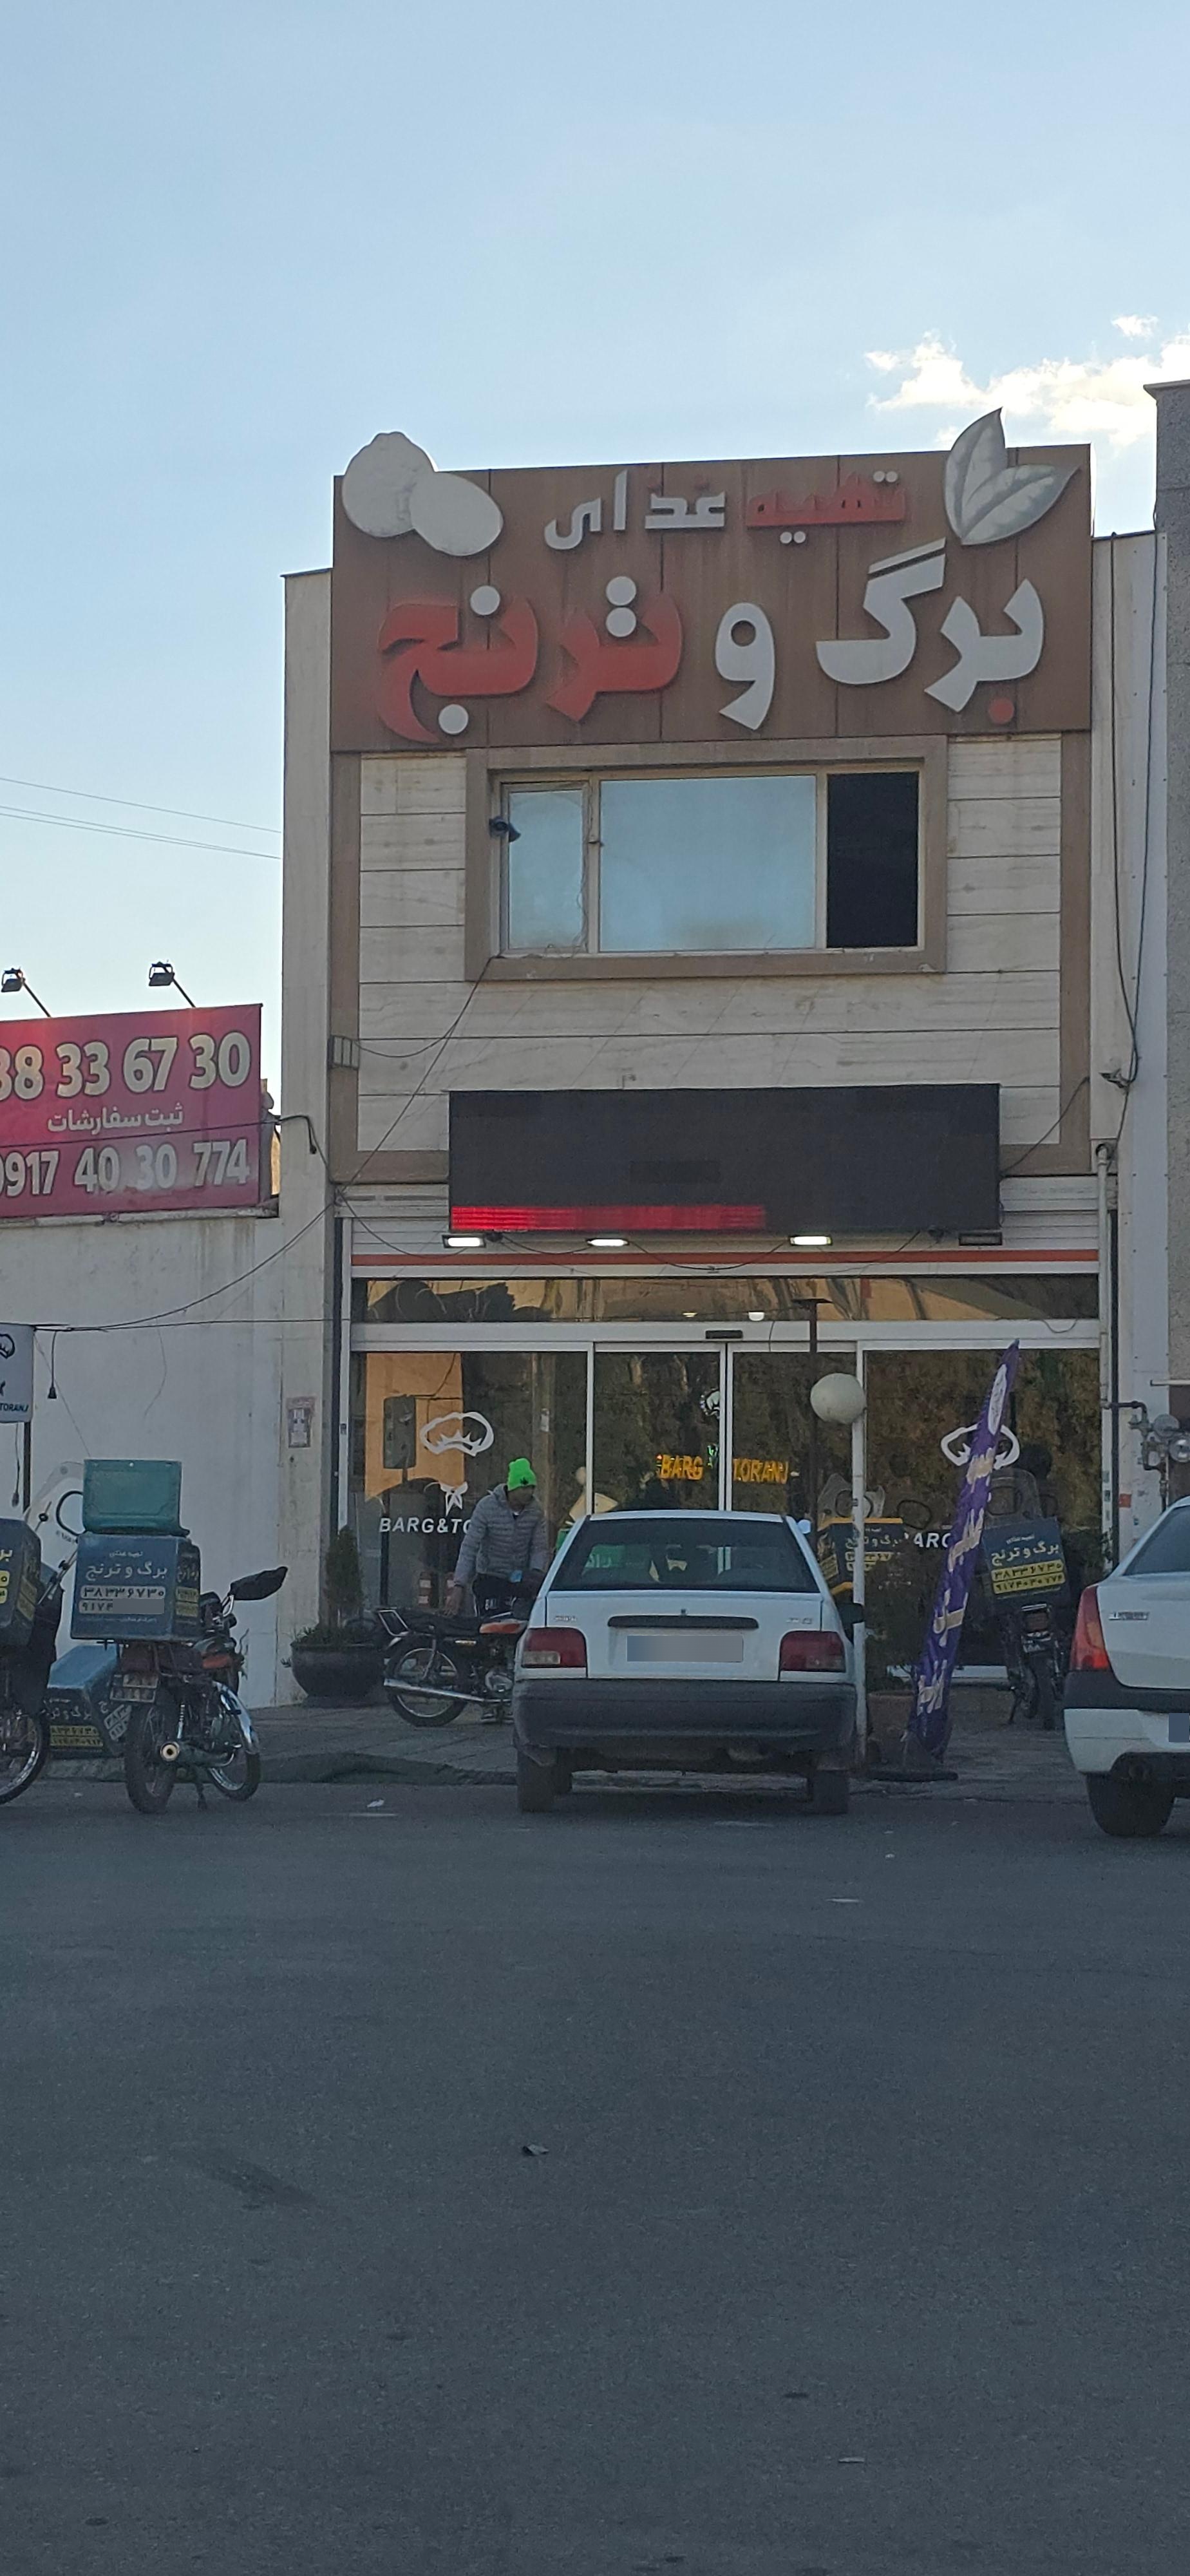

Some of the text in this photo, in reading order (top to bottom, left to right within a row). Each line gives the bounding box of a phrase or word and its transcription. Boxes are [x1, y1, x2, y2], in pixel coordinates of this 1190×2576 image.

[746, 471, 905, 544] تهیه
[378, 538, 1044, 743] برگ و ترنج
[56, 1041, 111, 1098] 33
[123, 1036, 178, 1093] 67
[189, 1031, 252, 1089] 30
[47, 1103, 184, 1135] ثبت سفارشات
[0, 1138, 250, 1197] 917 40 30 774
[660, 1454, 703, 1481] BARG
[86, 1561, 167, 1582] برگ و ترنج
[1023, 1547, 1031, 1558] و
